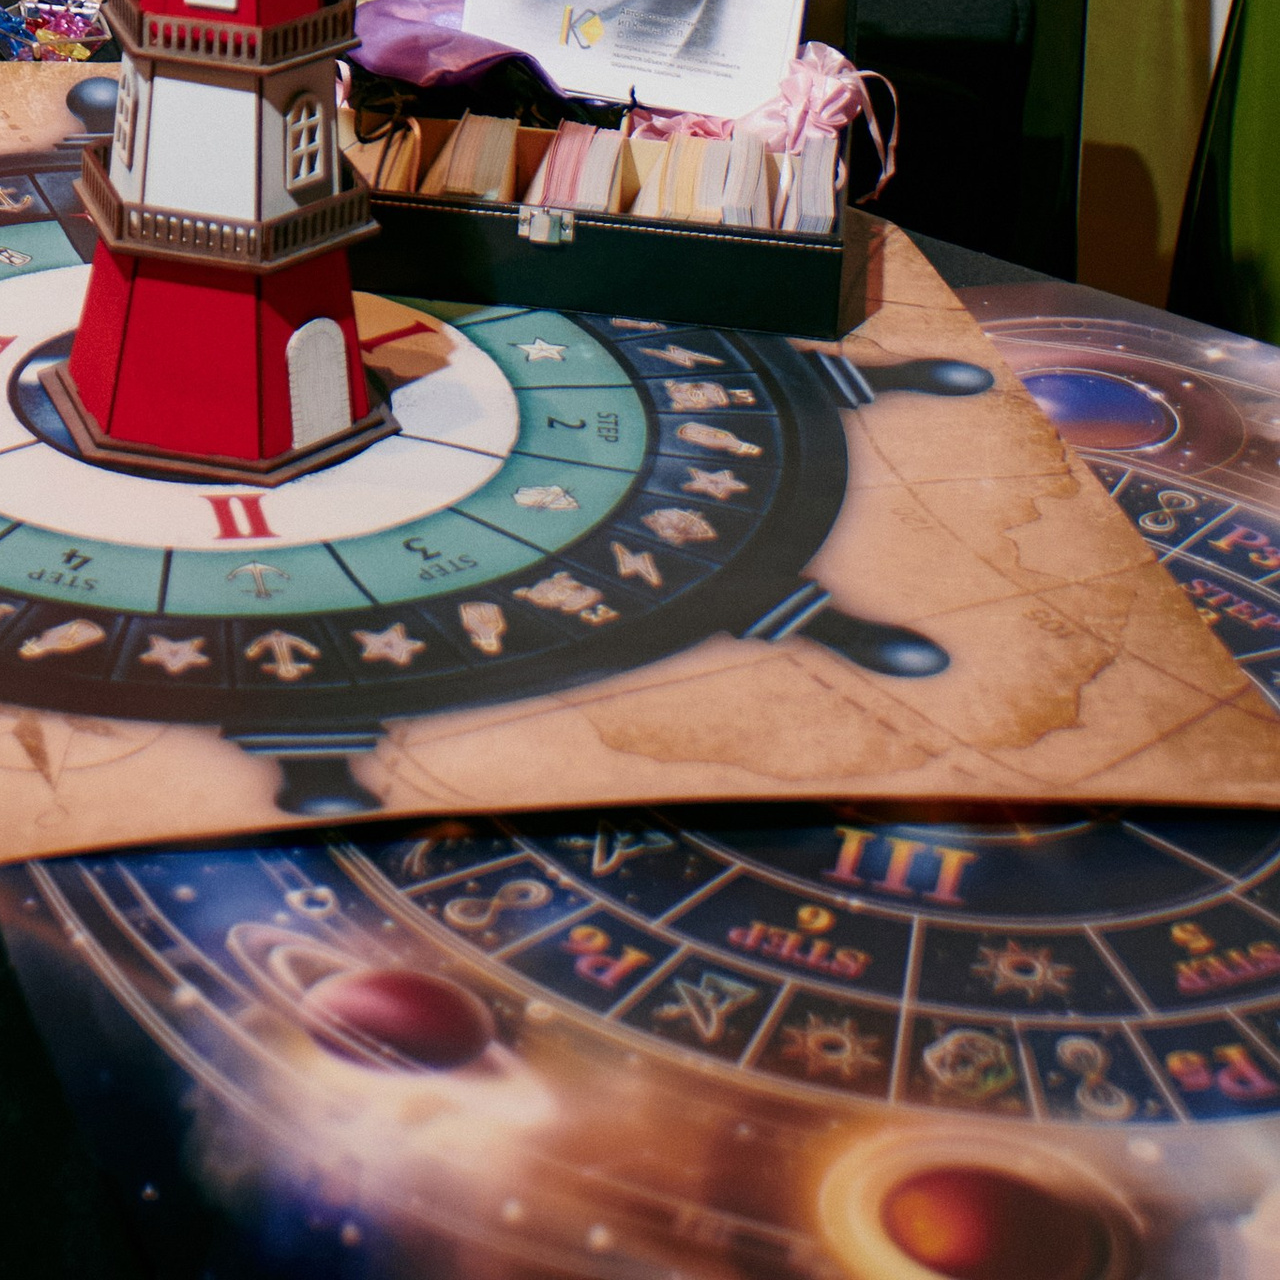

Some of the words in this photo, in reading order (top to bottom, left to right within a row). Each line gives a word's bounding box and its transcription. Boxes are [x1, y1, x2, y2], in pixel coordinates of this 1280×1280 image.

[546, 415, 588, 432] 2
[596, 410, 620, 444] STEP
[198, 492, 281, 540] II
[61, 547, 92, 577] 4
[402, 536, 442, 562] 3
[27, 567, 99, 593] STEP
[418, 552, 478, 583] STEP
[822, 825, 982, 907] III
